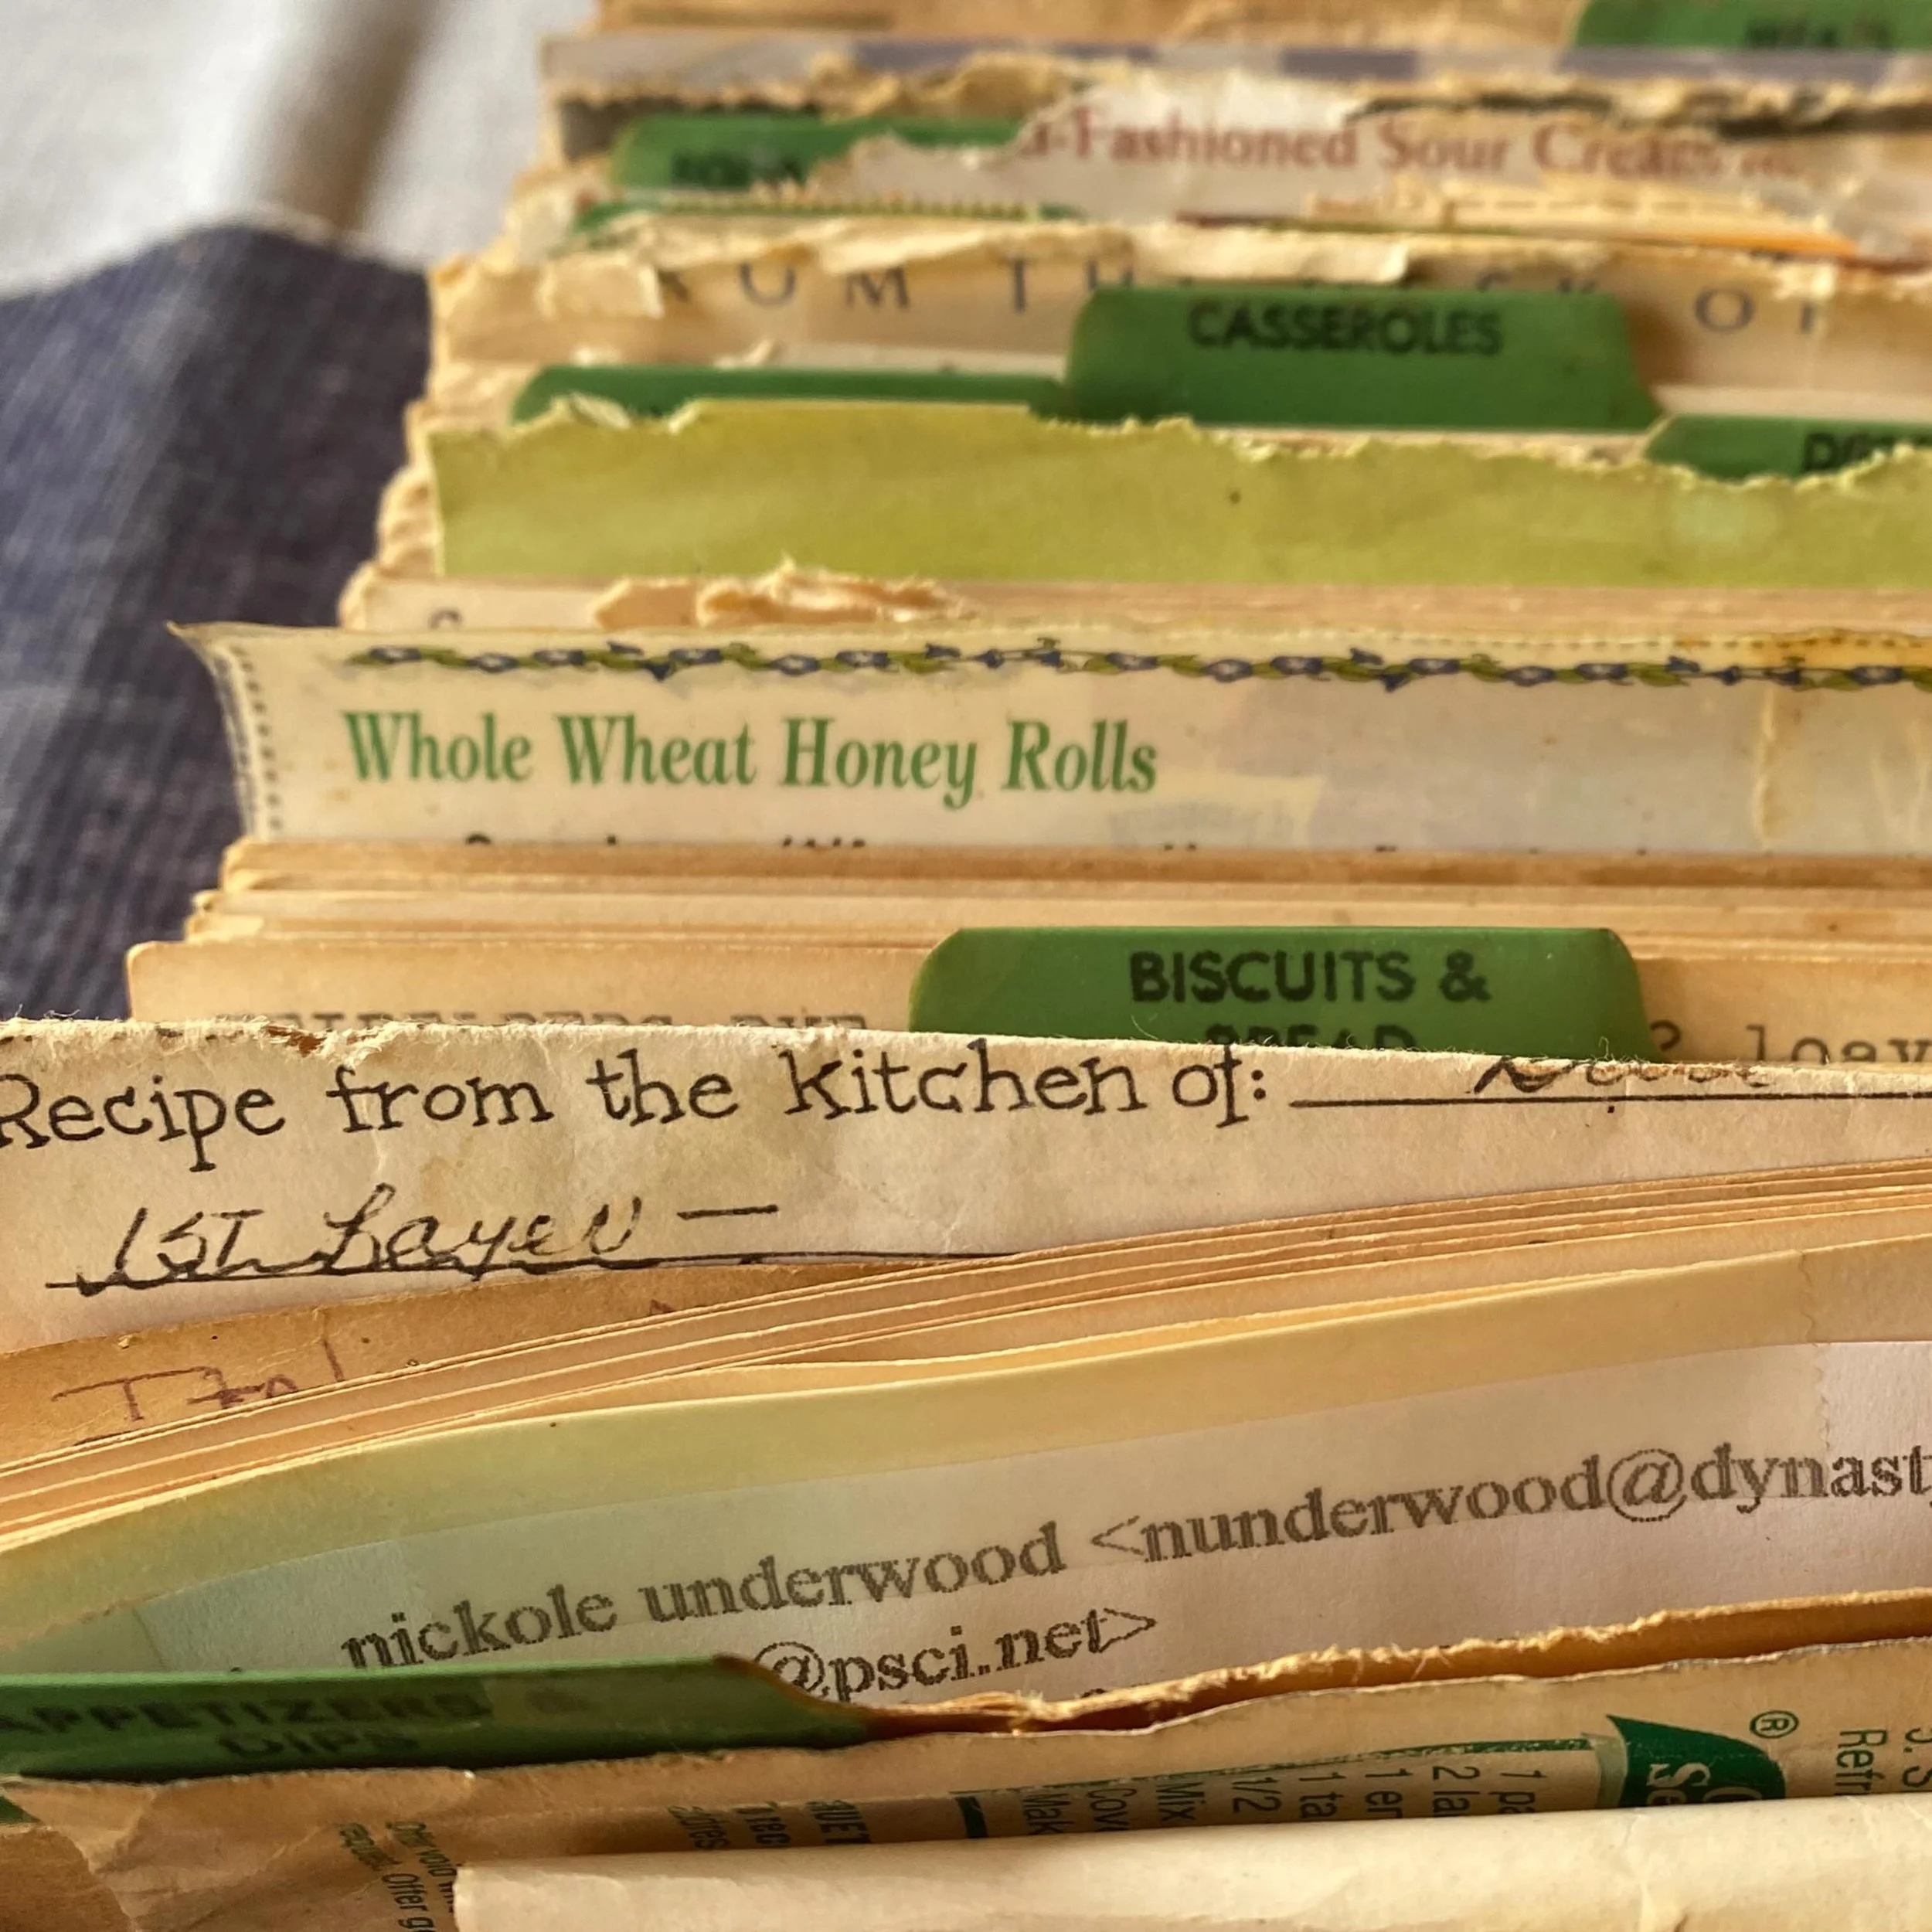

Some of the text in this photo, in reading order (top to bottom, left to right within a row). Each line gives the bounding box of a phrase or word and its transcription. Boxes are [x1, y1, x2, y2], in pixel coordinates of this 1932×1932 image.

[1378, 116, 1511, 172] Sour
[1189, 298, 1505, 355] CASSEROLES
[342, 709, 1159, 811] Whole Wheat Honey Rolls
[1130, 950, 1492, 1003] BISCUITS &
[0, 1037, 1267, 1172] Recipe from the kitchen of:
[340, 1583, 618, 1668] nickole
[638, 1519, 1066, 1624] underwood
[1299, 1771, 1347, 1781] 1
[1364, 1767, 1413, 1778] 1
[1835, 1728, 1889, 1795] Refr
[1087, 1787, 1138, 1832] Cov
[1156, 1781, 1206, 1822] Mix
[1232, 1777, 1282, 1814] 1/2
[1431, 1765, 1481, 1818] 2 la
